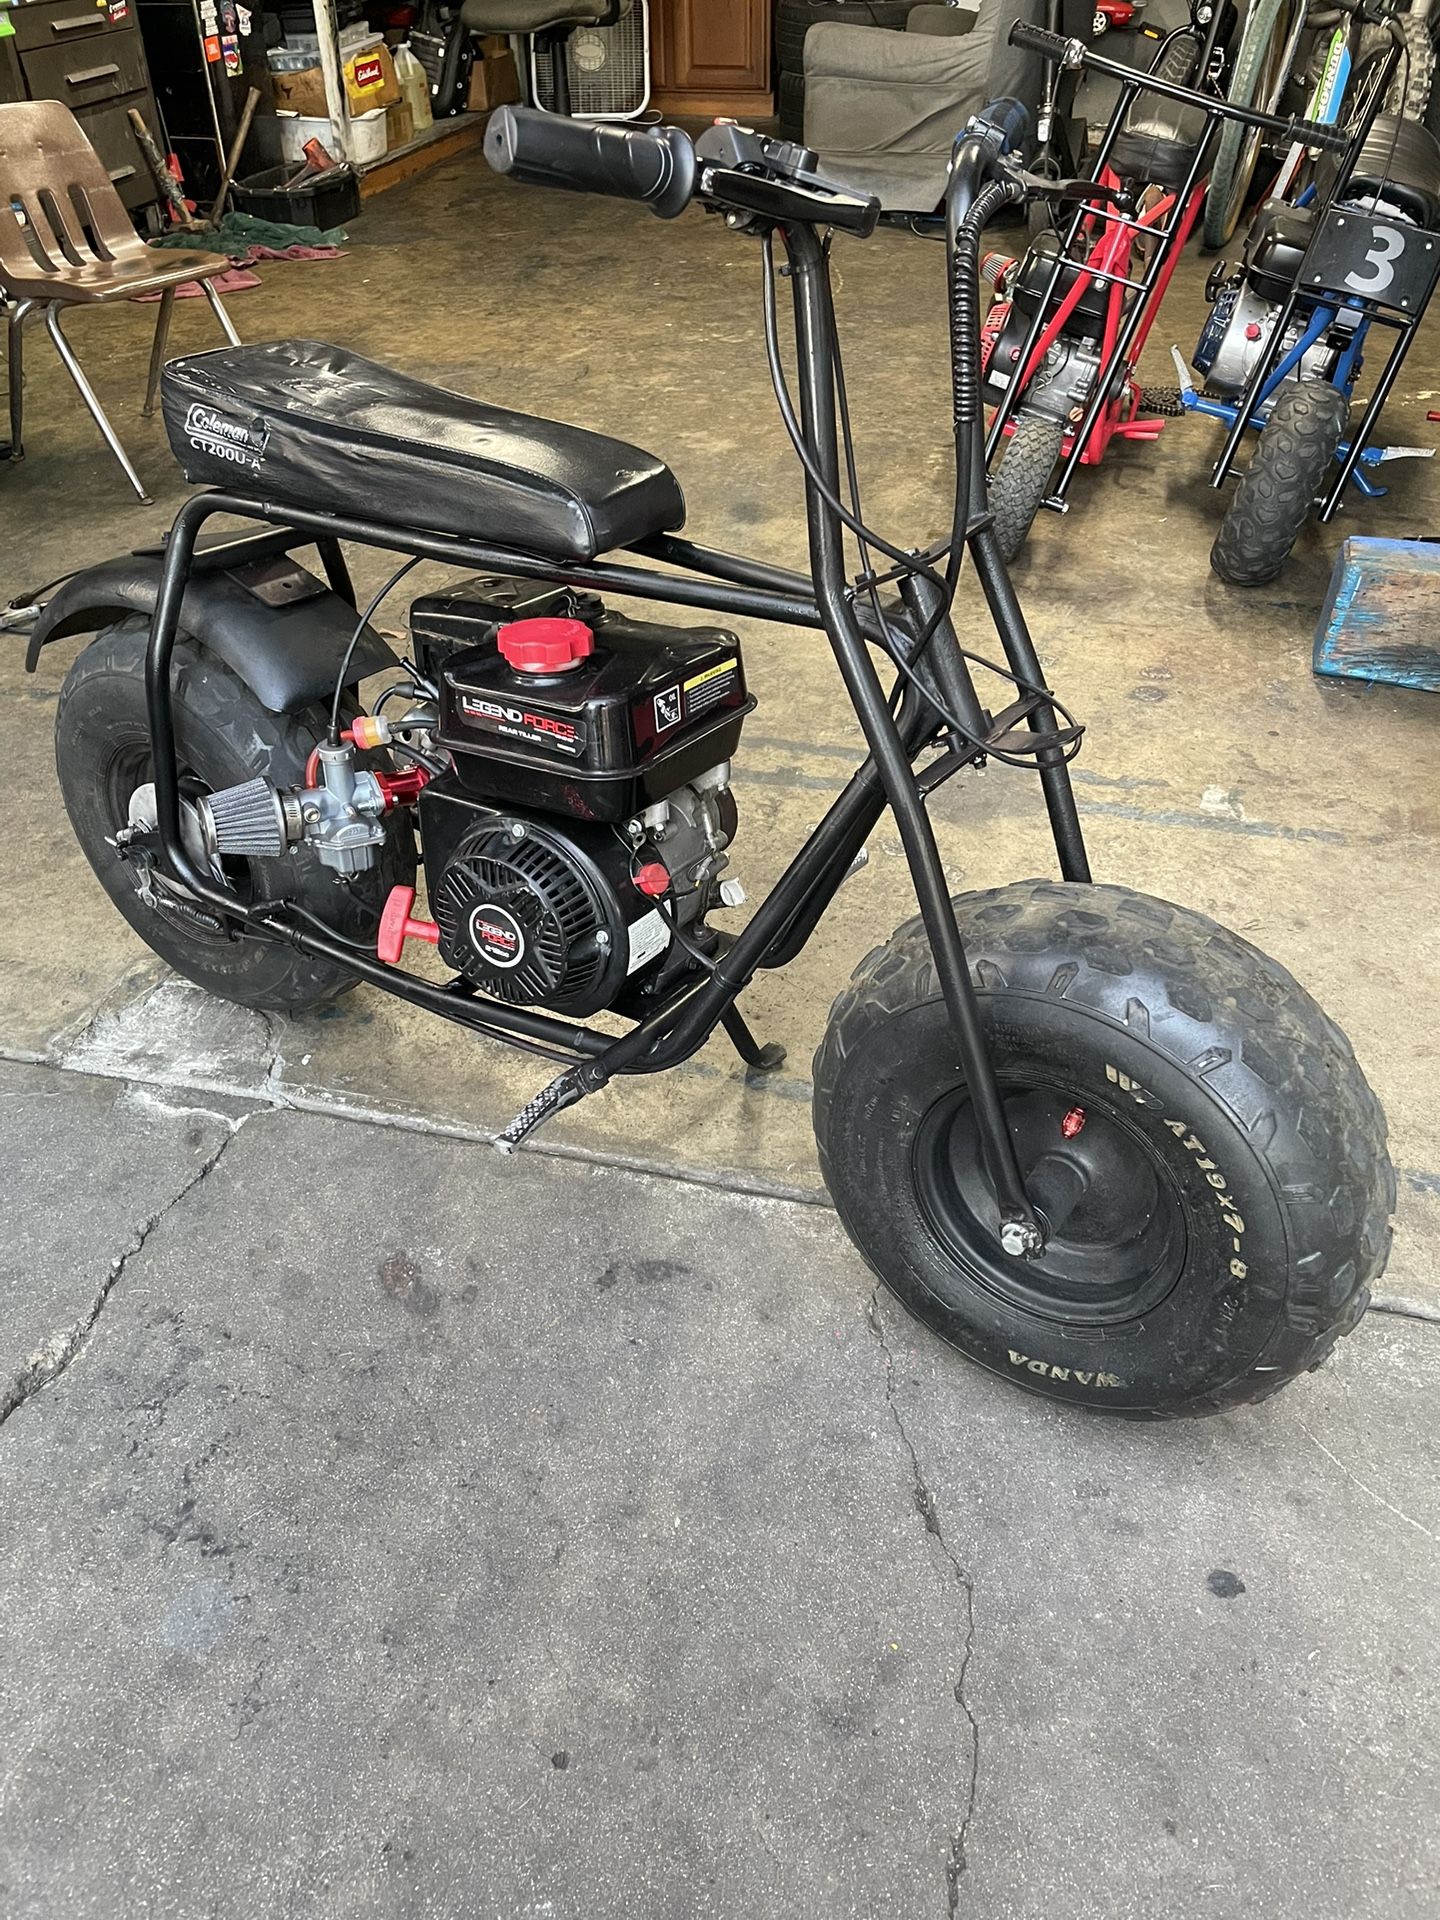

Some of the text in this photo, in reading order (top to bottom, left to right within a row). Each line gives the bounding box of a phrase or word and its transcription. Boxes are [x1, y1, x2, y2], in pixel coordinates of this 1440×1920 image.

[1318, 41, 1343, 119] DUNLOP
[1343, 225, 1405, 293] 3
[192, 408, 249, 443] Coleman
[190, 437, 261, 471] CT200U-A
[462, 696, 523, 723] LEGEND
[524, 713, 575, 738] FORCE
[475, 919, 516, 940] LEGEND
[1007, 1349, 1123, 1388] WANDA
